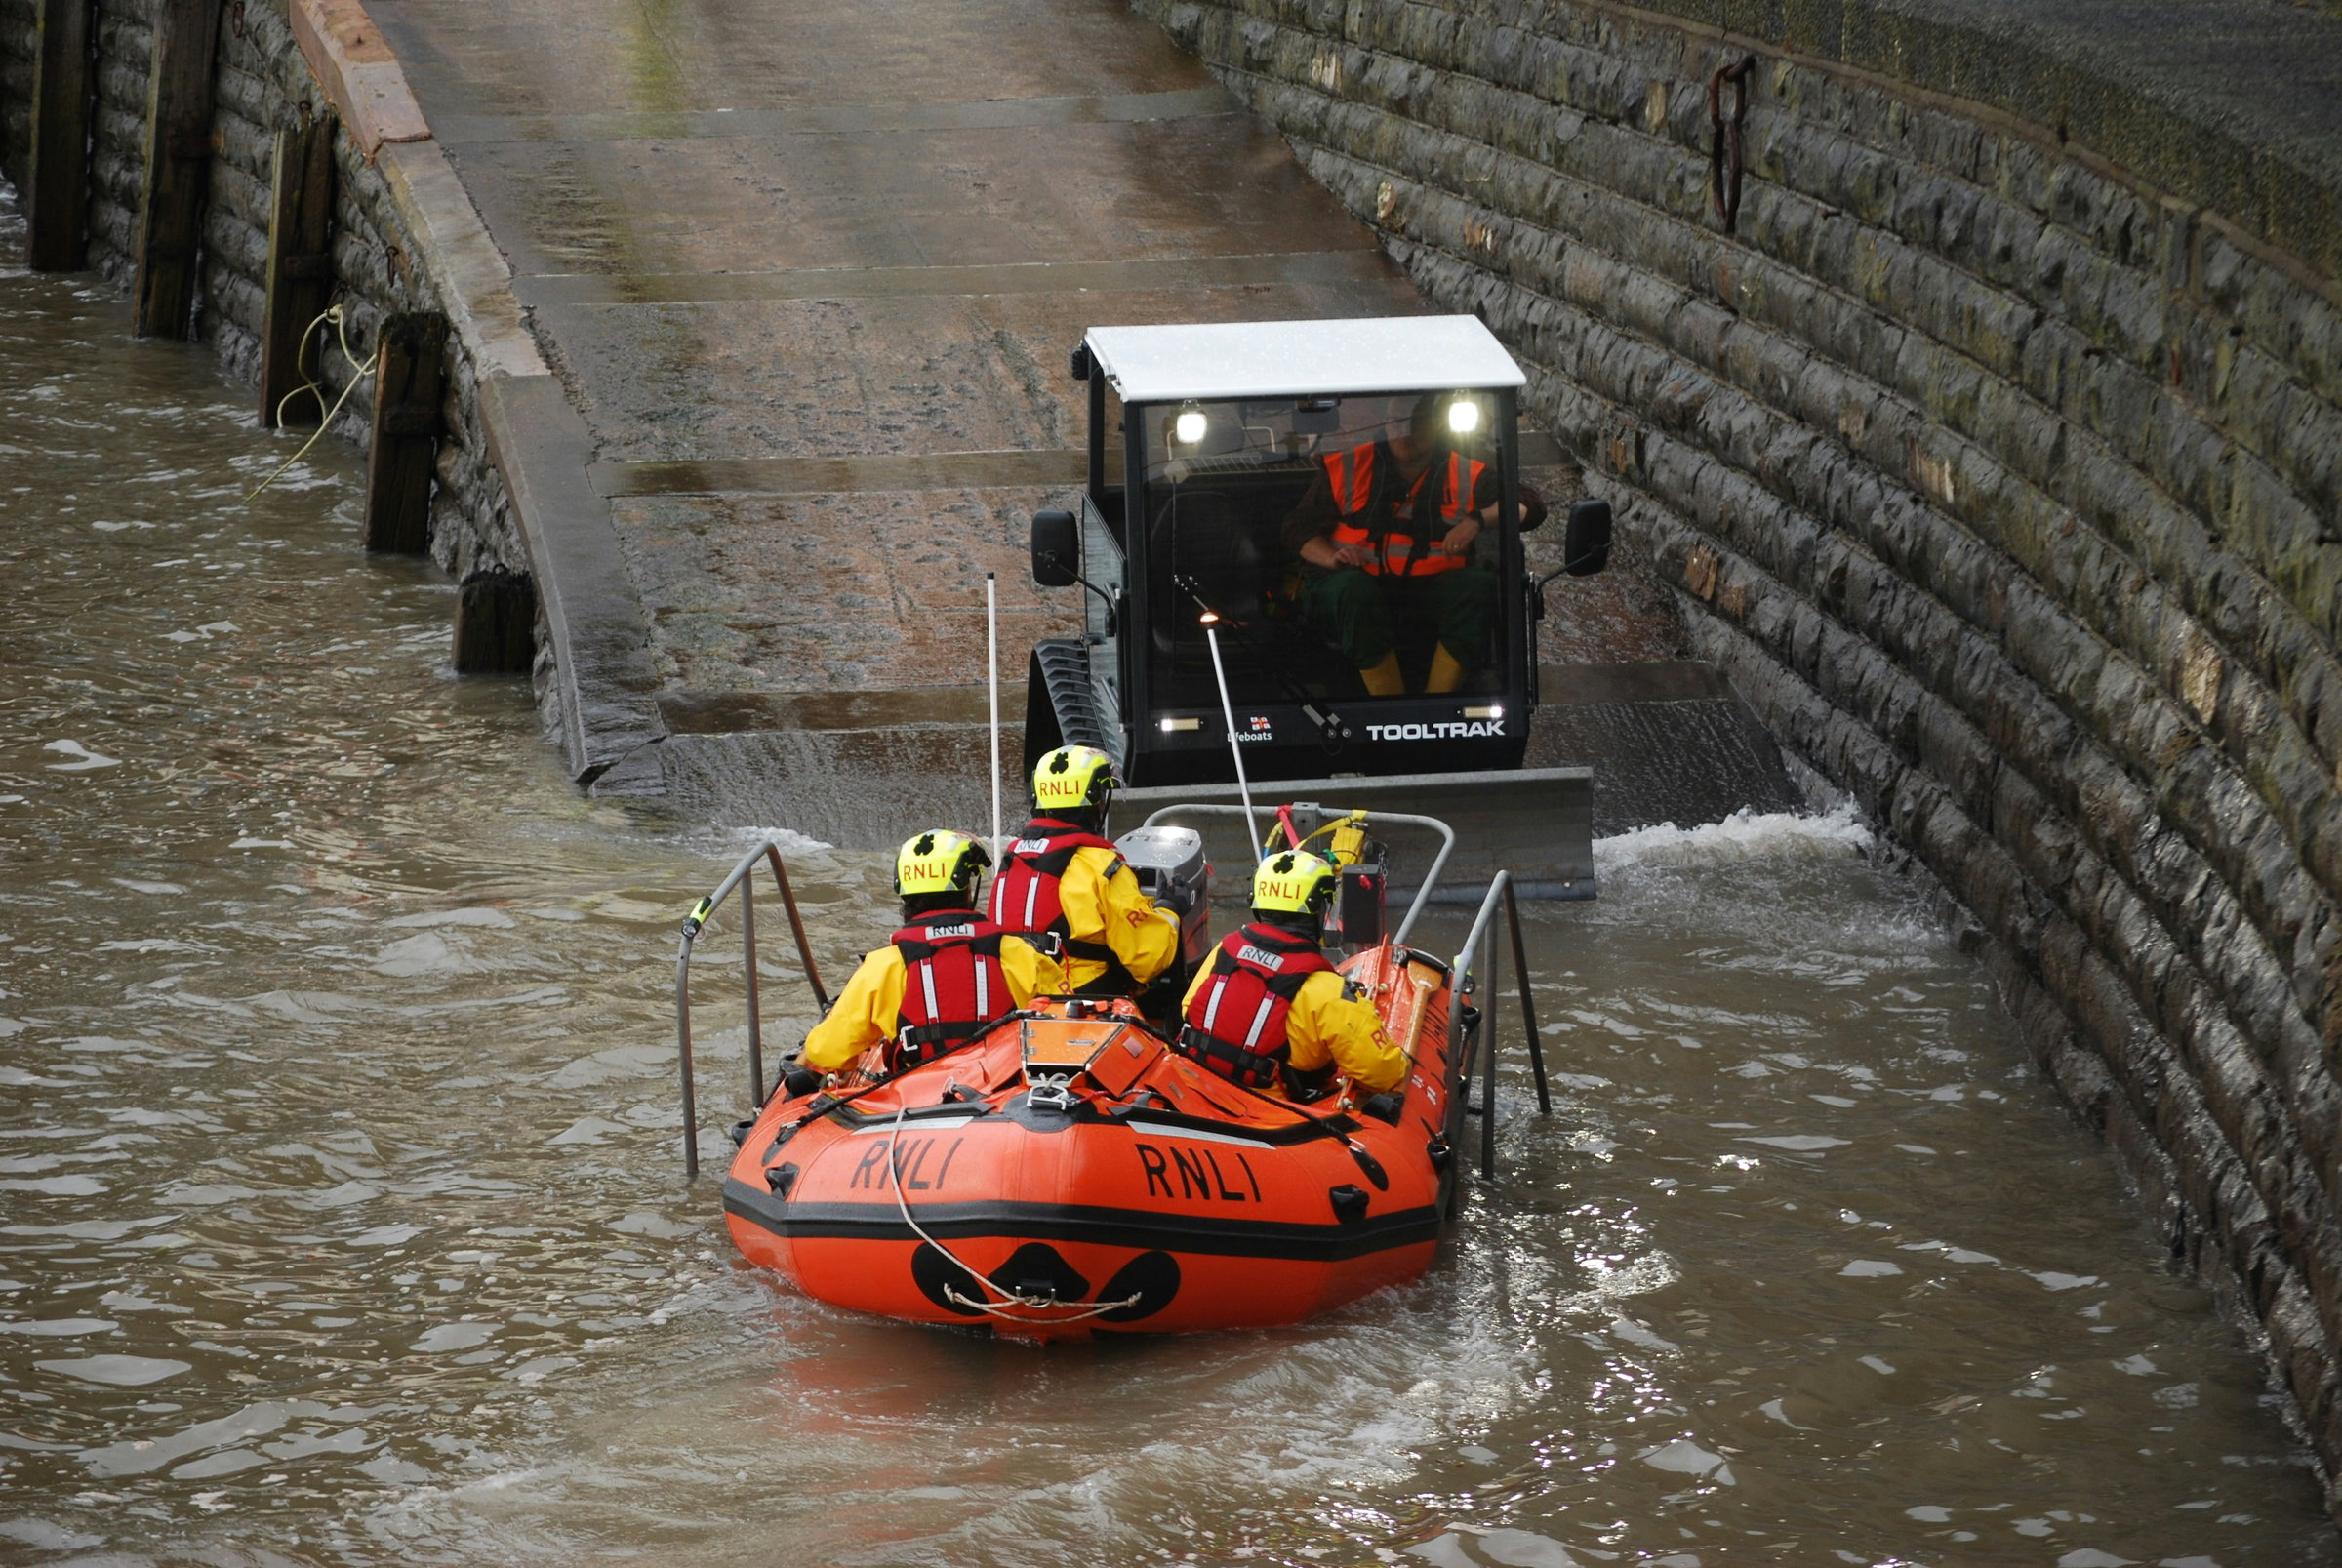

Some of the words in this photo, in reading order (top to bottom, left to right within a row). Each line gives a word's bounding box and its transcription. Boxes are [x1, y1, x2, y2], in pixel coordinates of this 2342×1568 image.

[1227, 732, 1272, 742] Lfeboats
[1366, 721, 1505, 740] TOOLTRAK
[1039, 780, 1080, 796] RNLI
[903, 863, 946, 881] RNLI
[1258, 881, 1301, 899] RNLI
[932, 925, 969, 937] RNLI
[1242, 948, 1277, 966] RNLI
[849, 1138, 964, 1189] RNLI
[1136, 1144, 1261, 1202] RNLI
